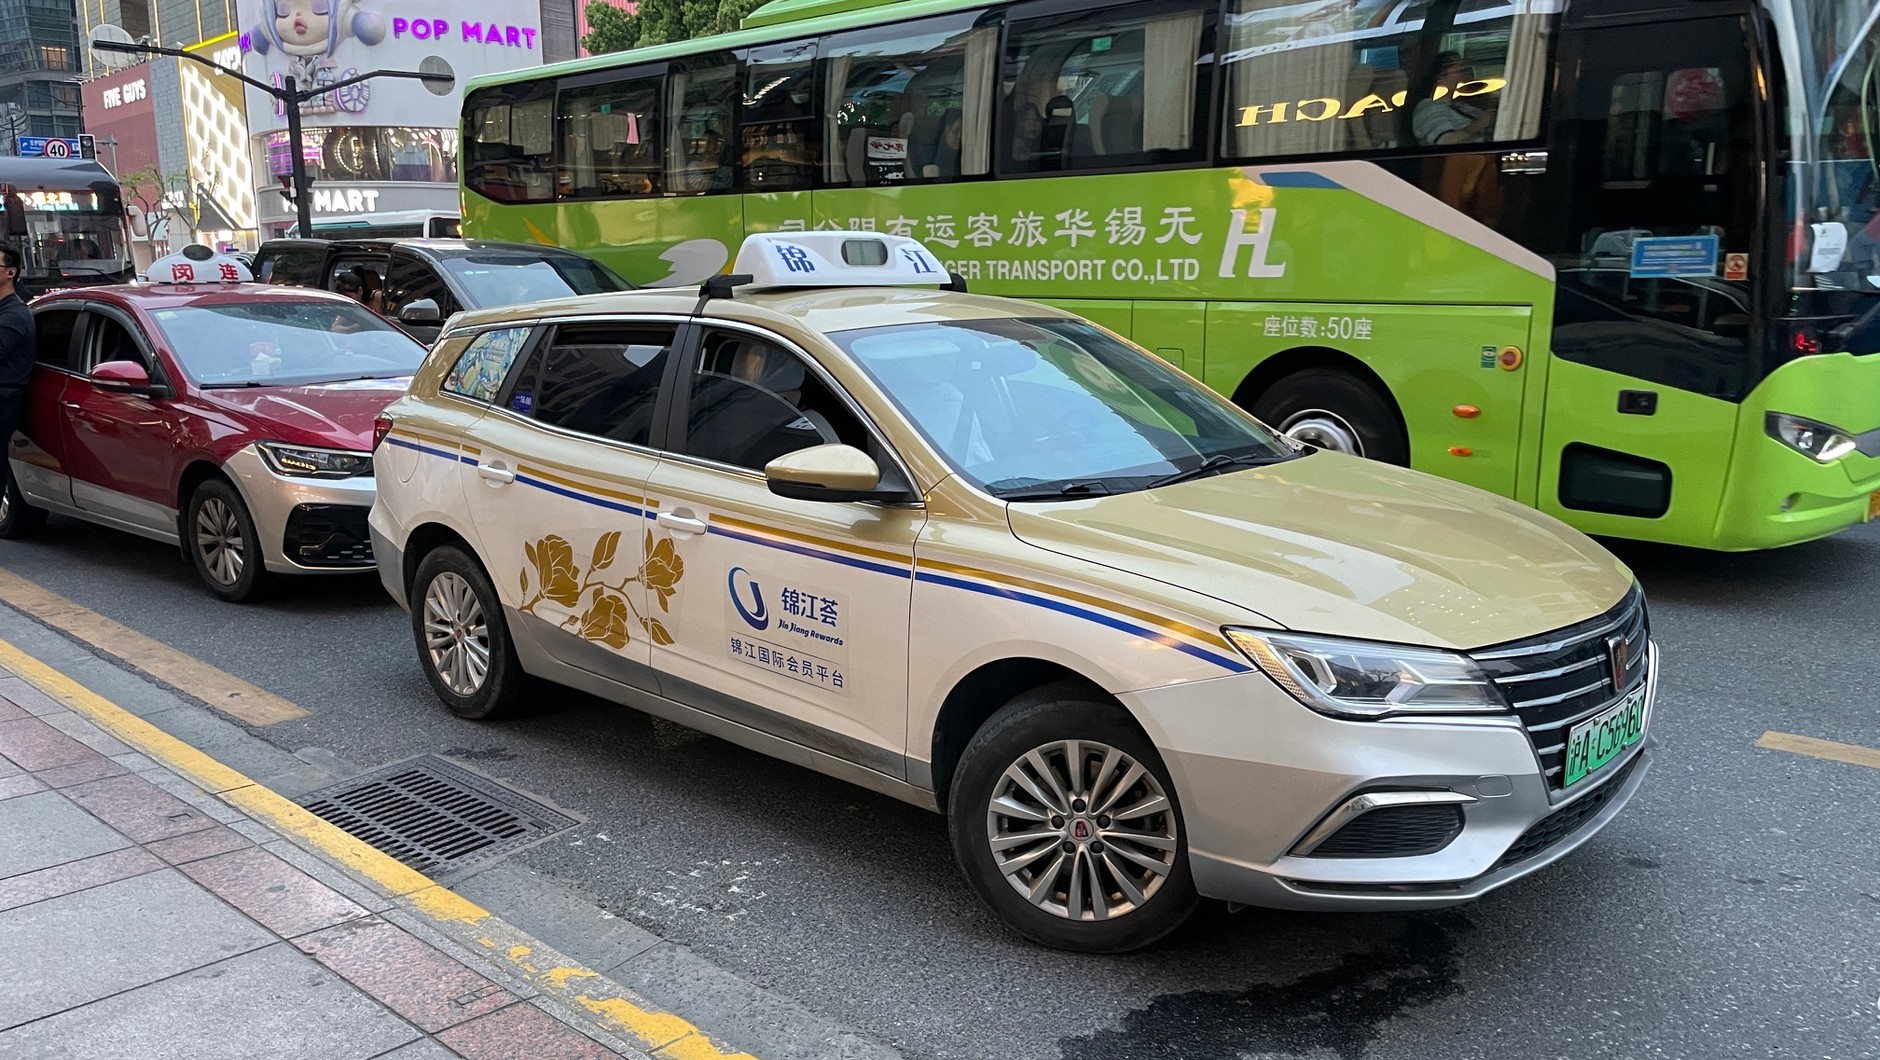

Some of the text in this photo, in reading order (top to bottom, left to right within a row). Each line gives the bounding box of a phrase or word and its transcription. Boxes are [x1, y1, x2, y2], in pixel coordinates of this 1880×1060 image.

[393, 17, 536, 49] POP MART
[103, 79, 146, 109] FIVE GUYS
[50, 144, 66, 157] 40
[314, 190, 379, 212] MART
[986, 259, 1106, 281] TRANSPORT
[781, 587, 838, 627] 锦江荟
[777, 618, 844, 646] Jin Jiang Rewards
[730, 636, 844, 689] 锦江国际会员平台
